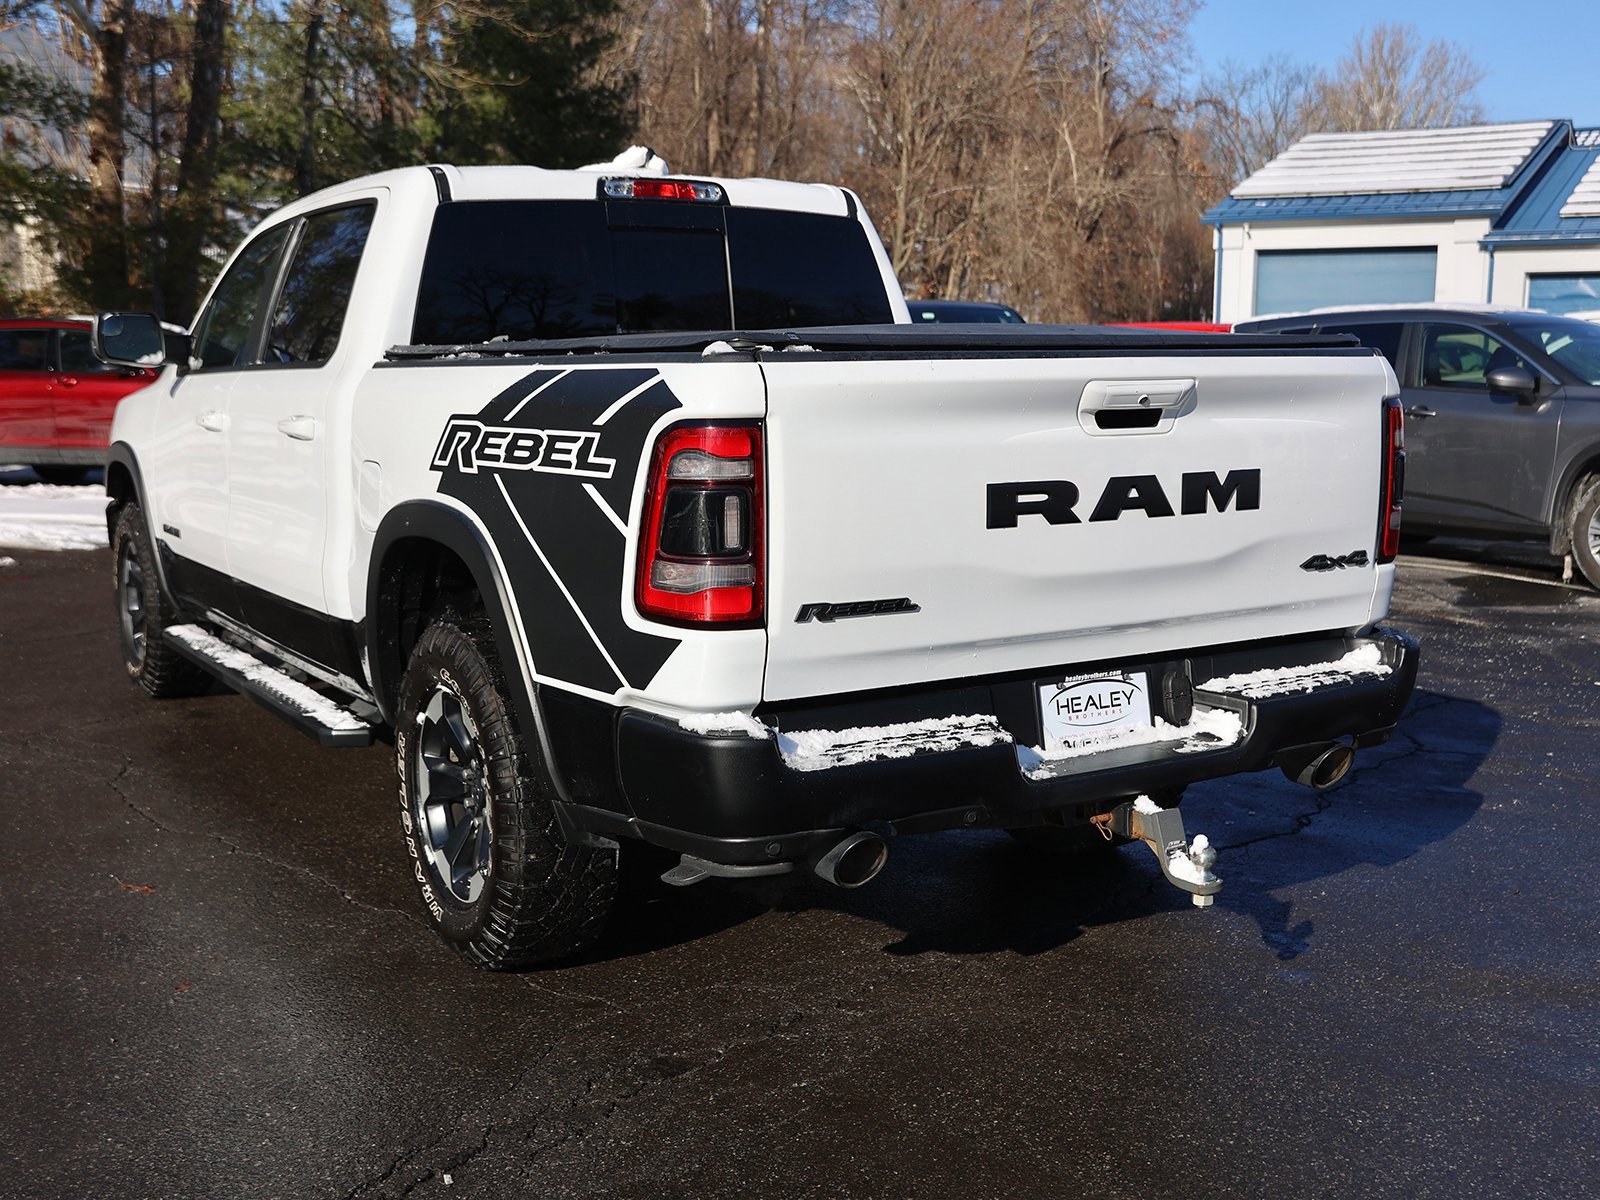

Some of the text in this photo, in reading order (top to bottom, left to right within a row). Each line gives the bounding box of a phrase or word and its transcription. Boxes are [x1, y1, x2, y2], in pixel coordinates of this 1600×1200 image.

[433, 419, 616, 479] REBEL
[986, 468, 1261, 529] RAM
[1299, 549, 1370, 572] 4x4
[794, 597, 921, 624] REBEL
[1056, 689, 1134, 716] HEALEY
[1068, 708, 1123, 721] BROTHERS
